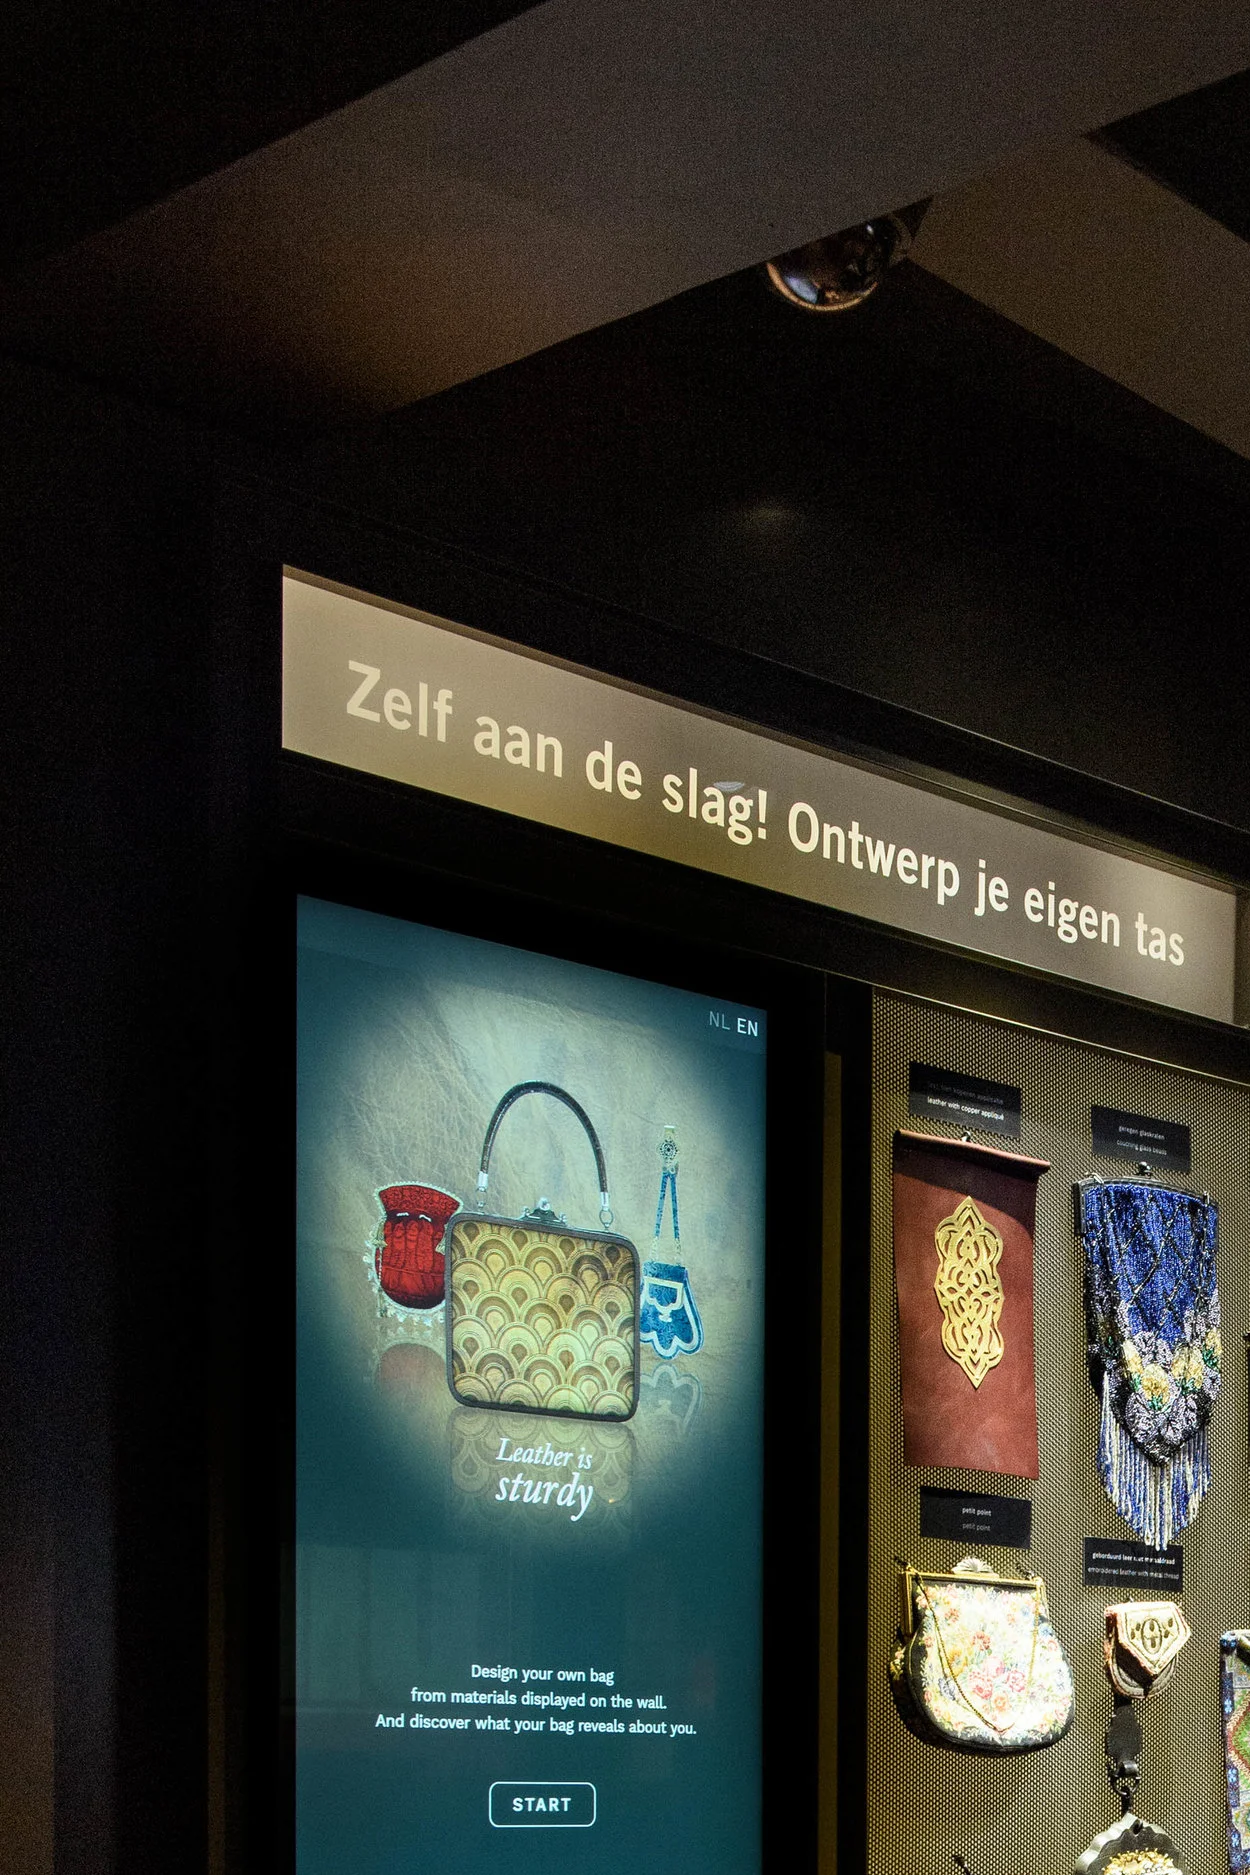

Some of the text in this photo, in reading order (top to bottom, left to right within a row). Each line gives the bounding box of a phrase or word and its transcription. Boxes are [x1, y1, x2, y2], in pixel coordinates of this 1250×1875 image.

[346, 660, 1185, 967] Zelf aan de slag! Ontwerp je eigen tas
[709, 1010, 758, 1036] NL EN
[496, 1437, 593, 1469] Leather is
[495, 1472, 594, 1521] sturdy
[471, 1664, 615, 1686] Design your own bag
[411, 1687, 667, 1710] from materials displayed on the wall.
[375, 1713, 697, 1738] And discover what your bag reveals about you.
[512, 1797, 572, 1812] START
